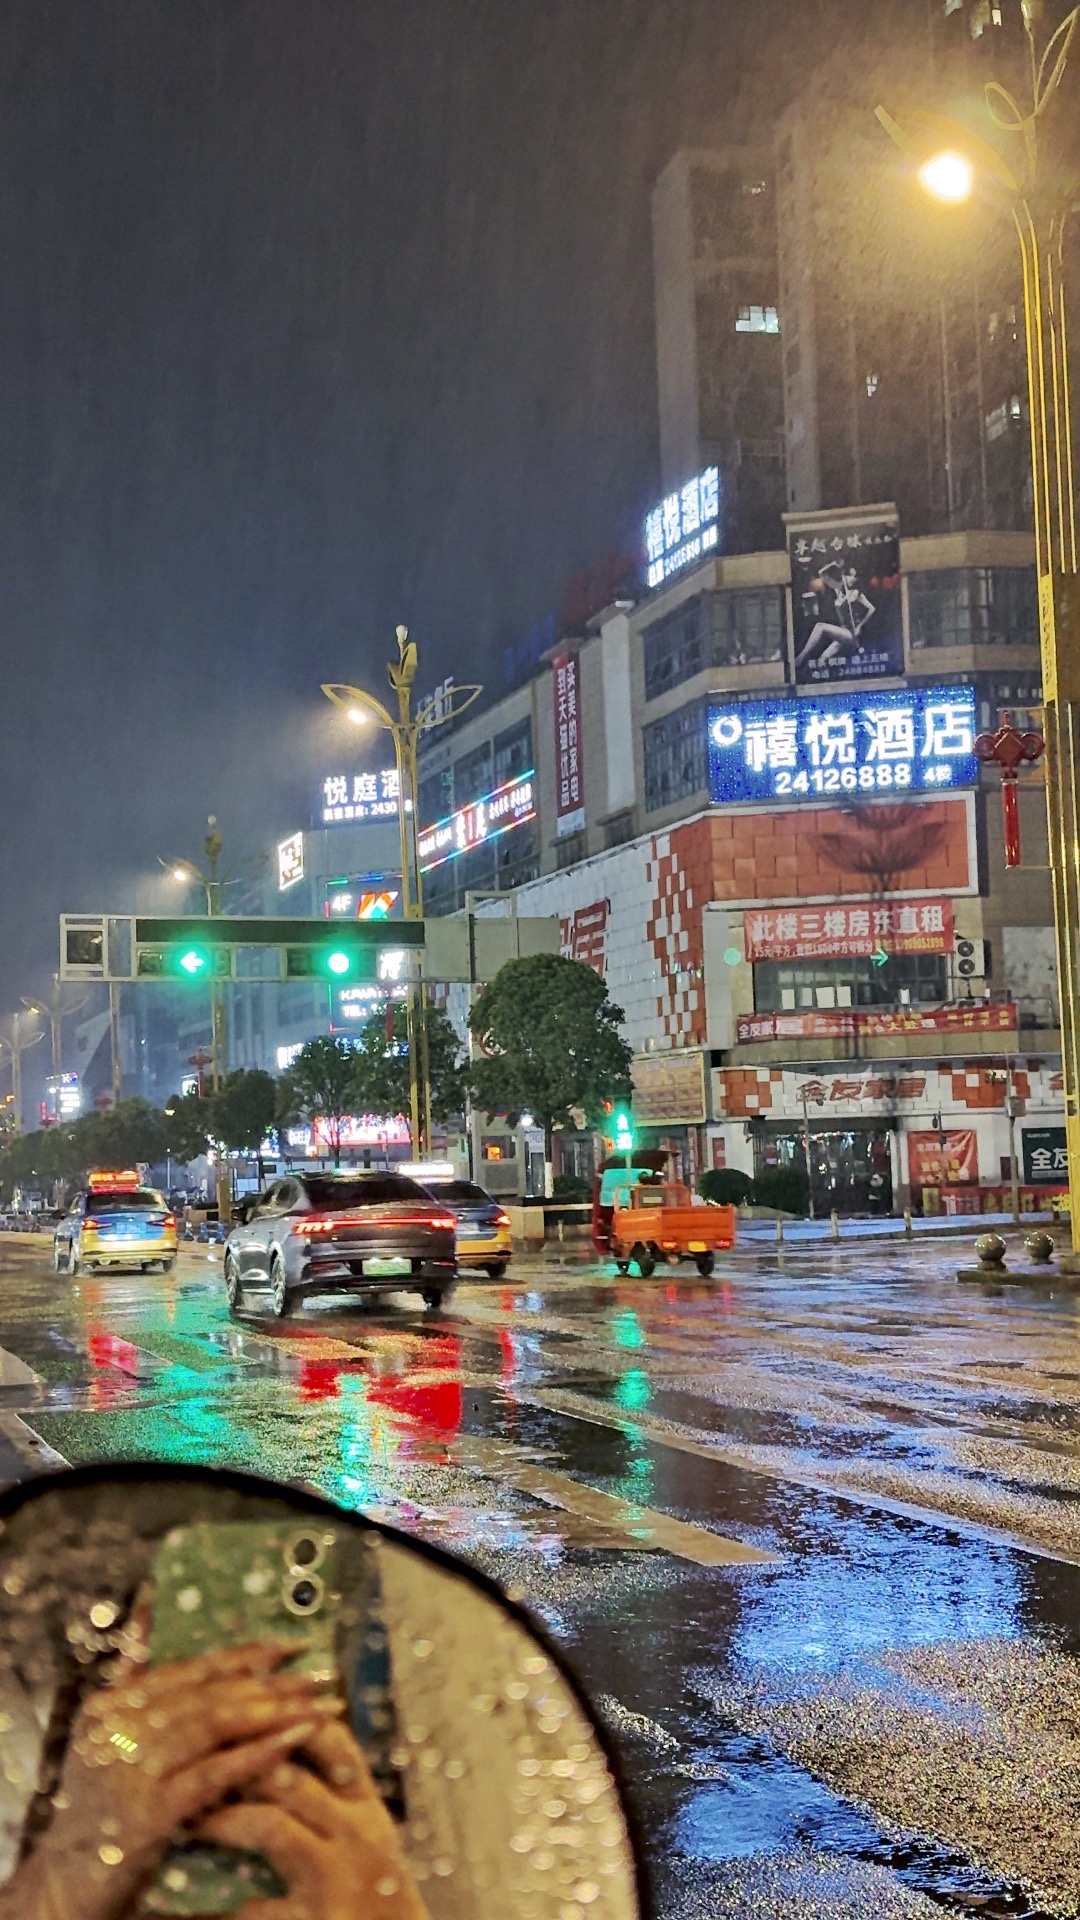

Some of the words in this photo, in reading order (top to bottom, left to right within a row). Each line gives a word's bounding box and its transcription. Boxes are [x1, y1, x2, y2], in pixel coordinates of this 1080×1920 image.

[745, 703, 973, 772] 禧悦酒店
[775, 764, 911, 794] 24126888
[752, 905, 946, 943] 此楼三楼房东直租
